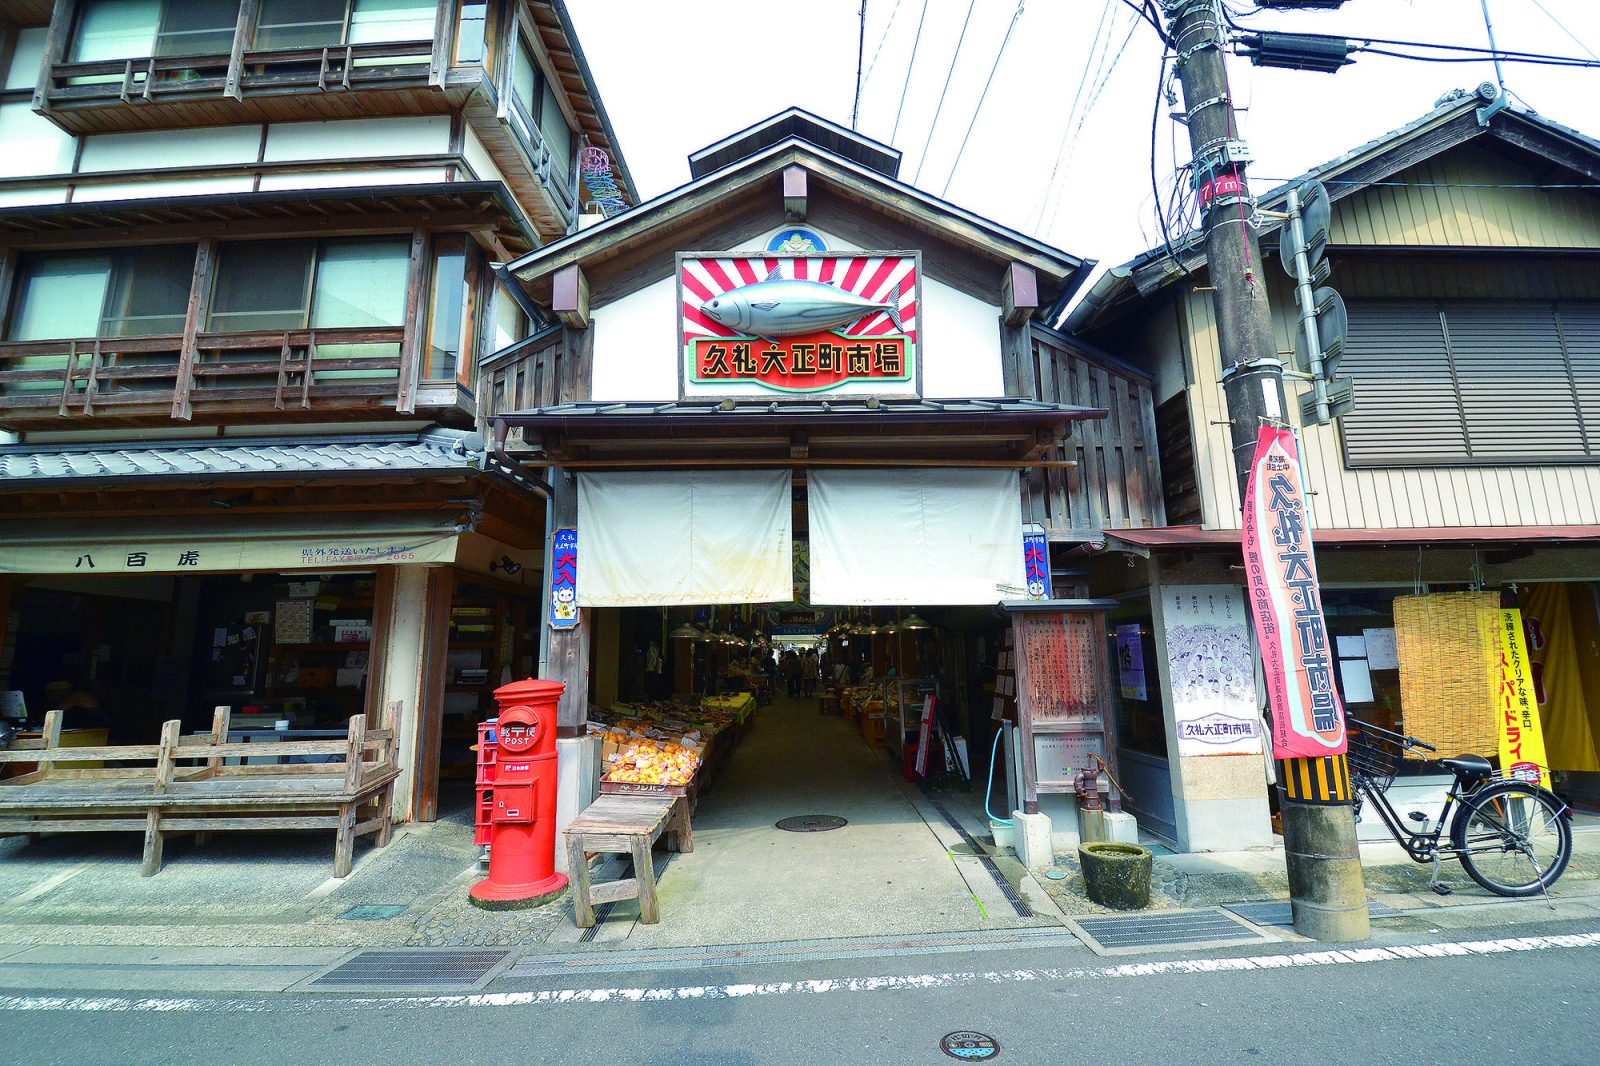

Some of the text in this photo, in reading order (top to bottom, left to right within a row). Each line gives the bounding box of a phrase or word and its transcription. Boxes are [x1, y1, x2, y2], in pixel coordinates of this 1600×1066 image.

[702, 343, 900, 374] 久礼大正町市場
[75, 550, 200, 568] 八百虎
[302, 546, 411, 557] 県外発送いたします
[387, 552, 415, 560] 2665
[556, 552, 577, 585] 大入
[1503, 612, 1532, 732] 洗練されたクリアな味、辛口。
[1185, 723, 1252, 736] 久礼大正町市場
